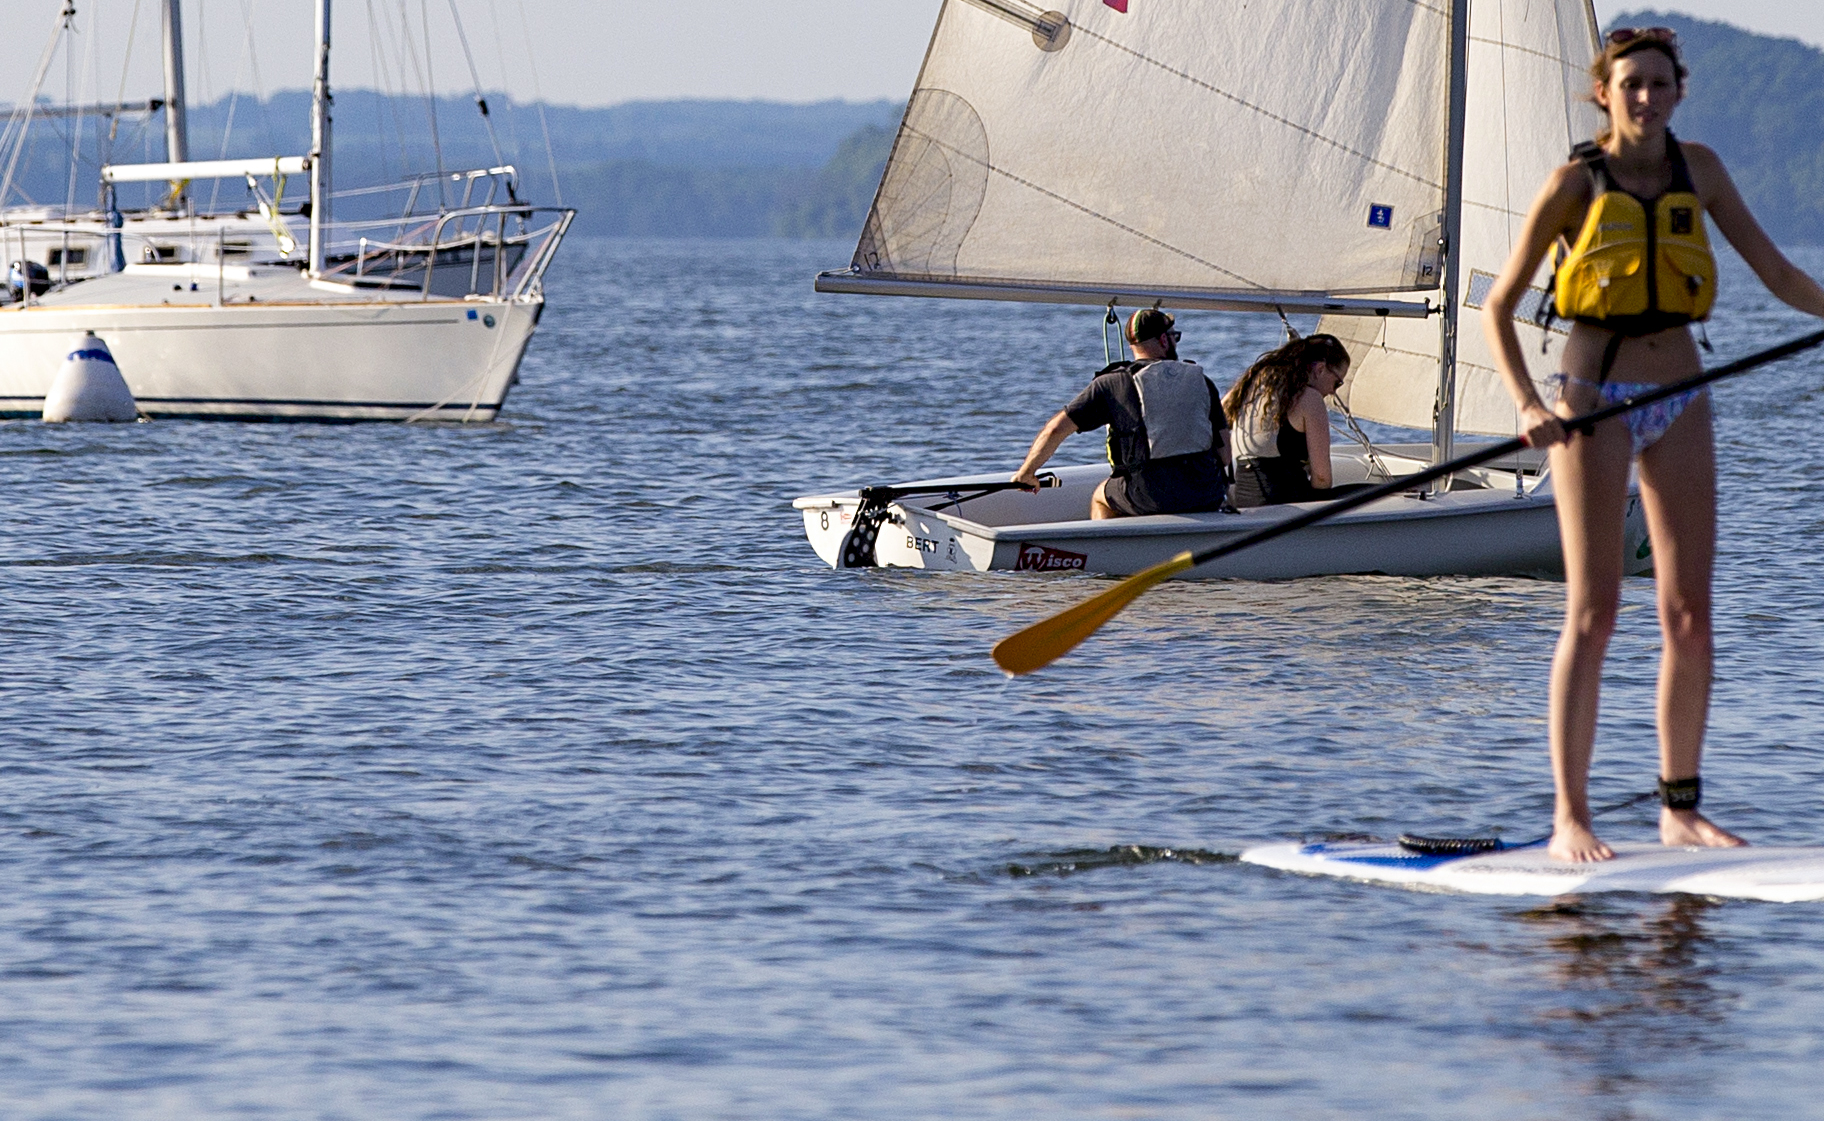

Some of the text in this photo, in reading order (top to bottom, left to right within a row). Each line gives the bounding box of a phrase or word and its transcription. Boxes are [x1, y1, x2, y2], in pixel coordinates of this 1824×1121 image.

[1421, 264, 1434, 278] 12
[820, 510, 830, 531] 8
[906, 536, 939, 554] BERT
[1021, 546, 1083, 570] Wisco
